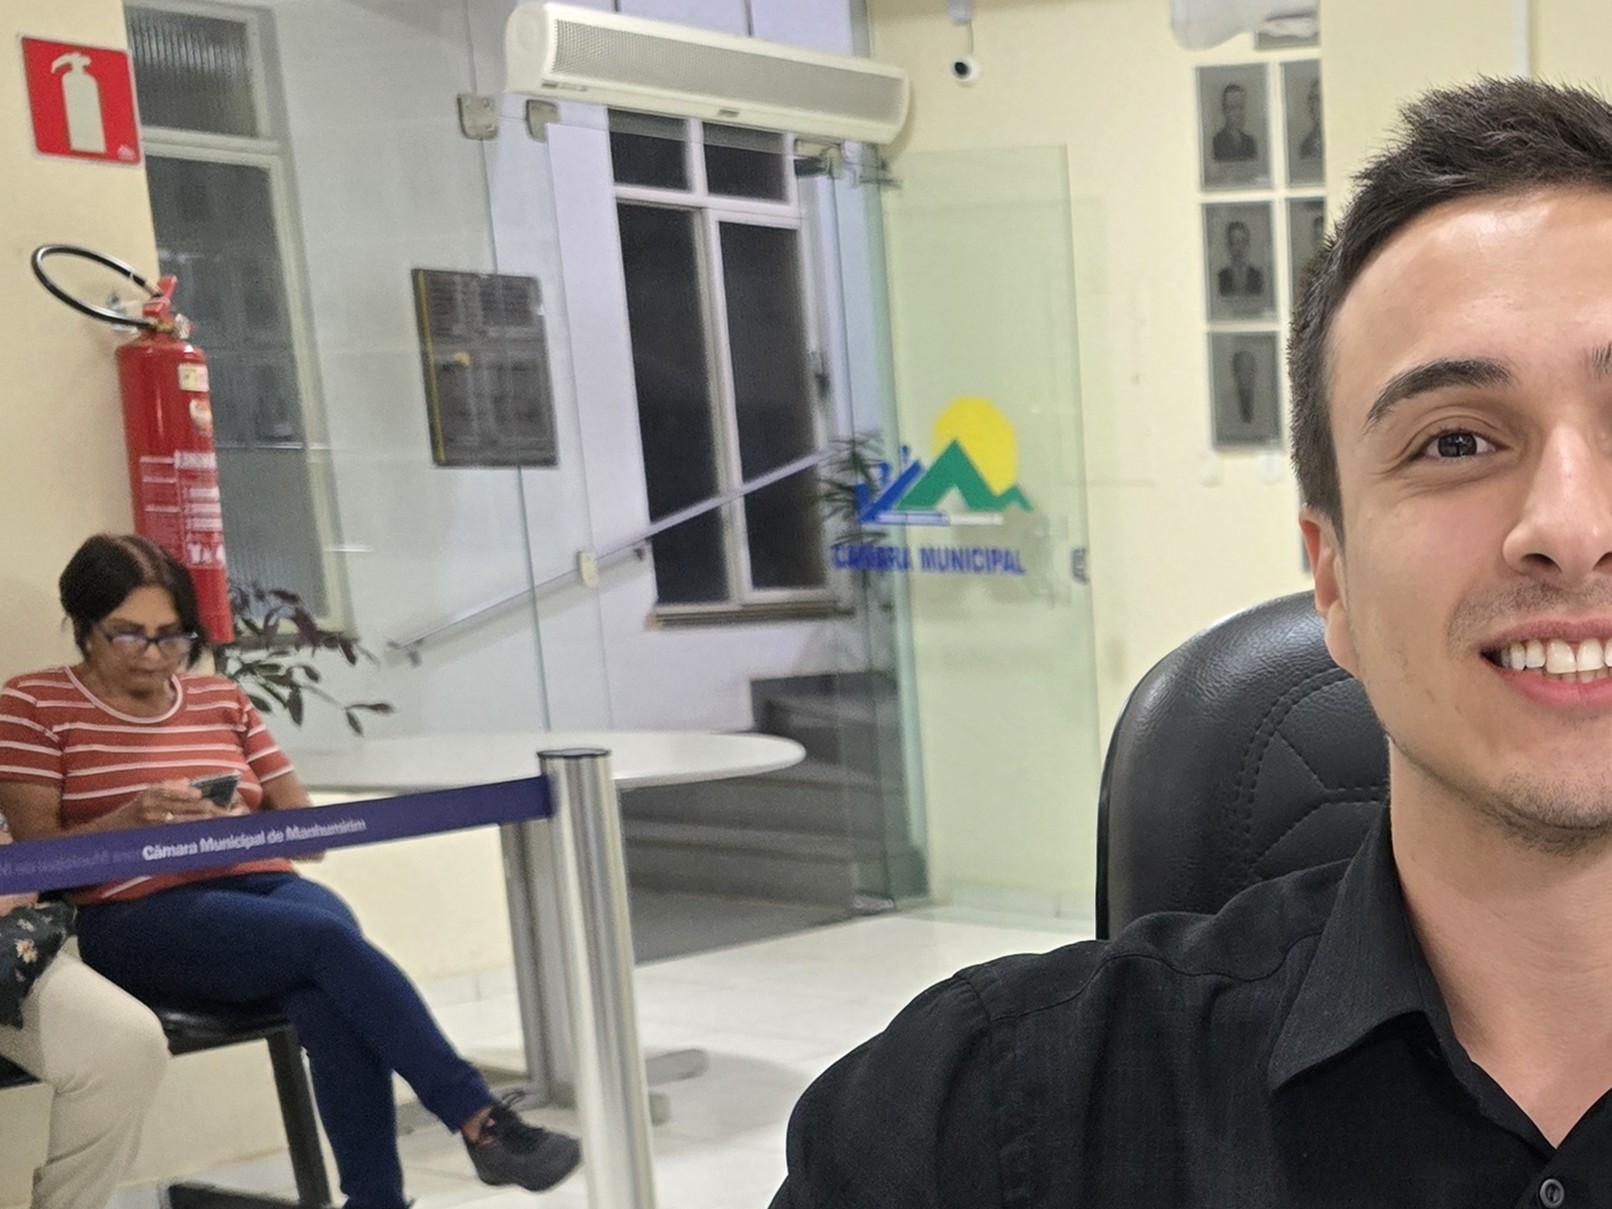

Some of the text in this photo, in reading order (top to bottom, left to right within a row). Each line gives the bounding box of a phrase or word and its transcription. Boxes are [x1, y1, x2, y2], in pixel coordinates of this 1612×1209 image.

[919, 547, 1027, 575] MUNICIPAL
[141, 842, 199, 861] Câmara
[199, 832, 266, 854] Municipal
[266, 828, 285, 843] de
